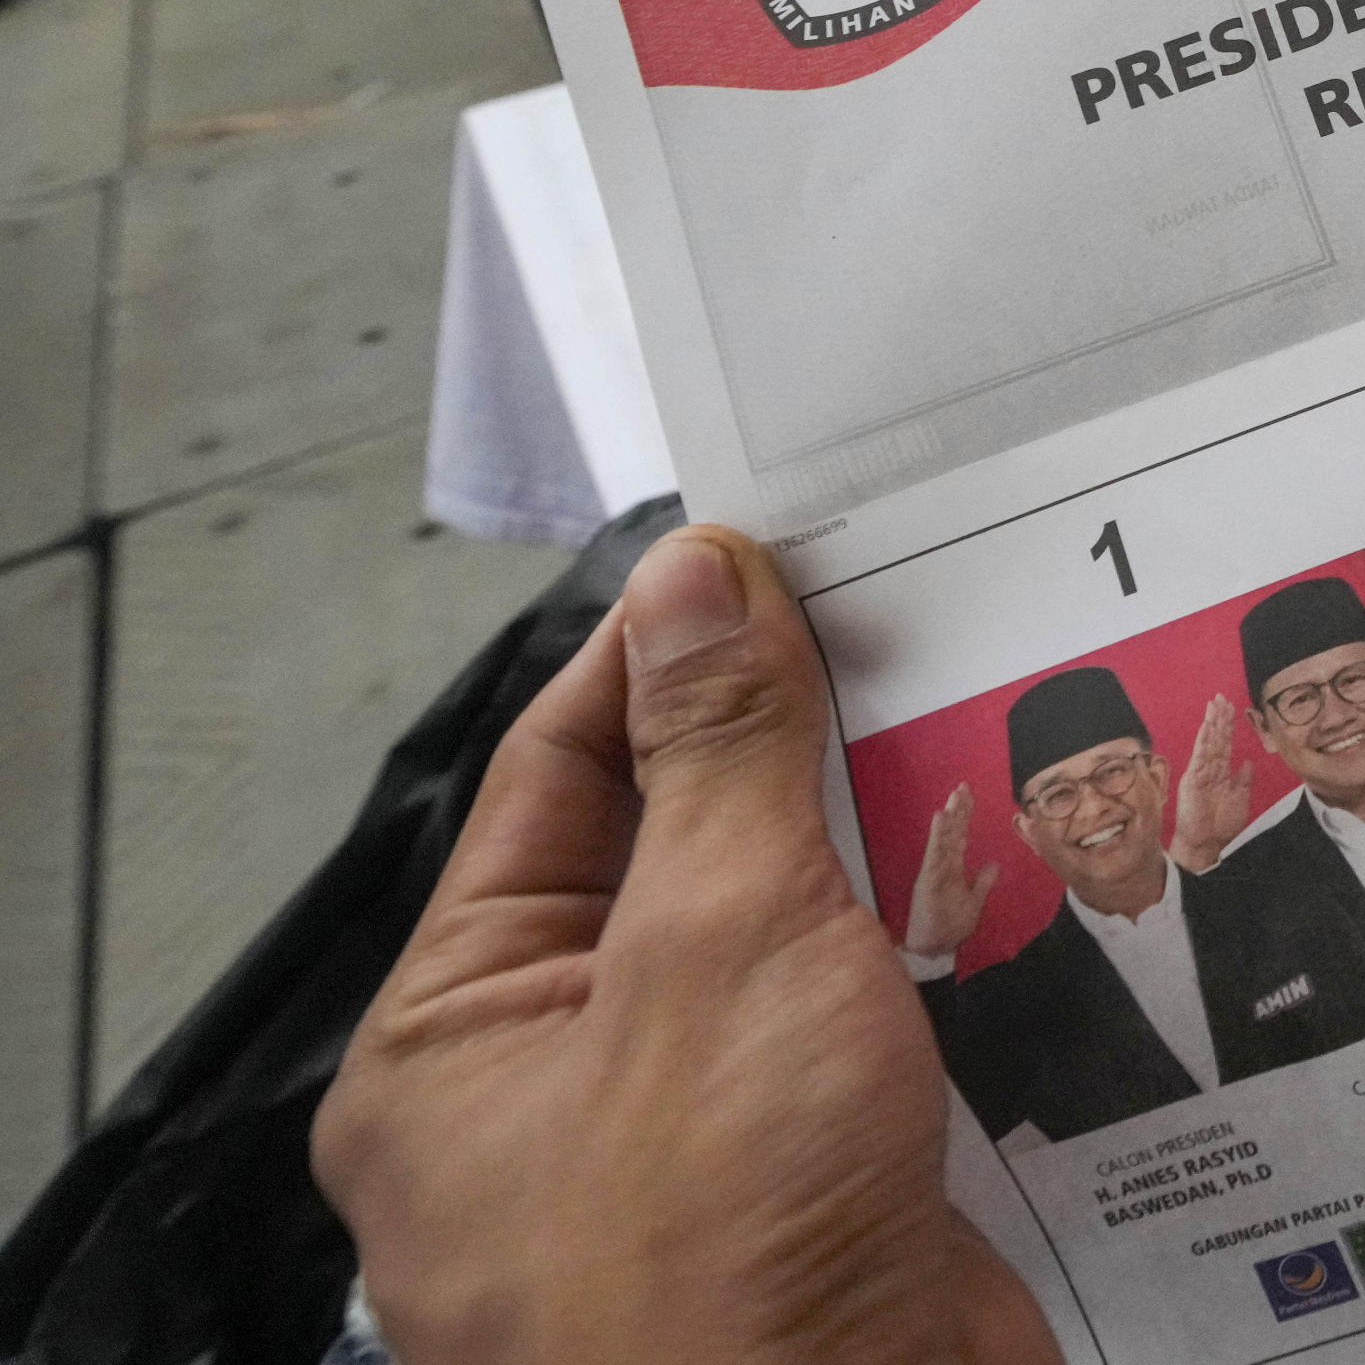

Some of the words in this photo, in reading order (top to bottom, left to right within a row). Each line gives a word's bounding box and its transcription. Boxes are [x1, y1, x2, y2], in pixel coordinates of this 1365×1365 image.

[1090, 519, 1138, 597] 1
[1254, 973, 1313, 1019] AMIN
[1094, 1186, 1118, 1205] H.
[1121, 1165, 1180, 1197] ANIES
[1182, 1140, 1259, 1177] RASYID
[1096, 1148, 1153, 1177] CALON
[1156, 1121, 1236, 1158] PRESIDEN
[1103, 1179, 1224, 1228] BASWEDAN,
[1225, 1163, 1272, 1190] Ph.D
[1191, 1217, 1289, 1256] GABUNGAN
[1291, 1199, 1351, 1227] PARTAI
